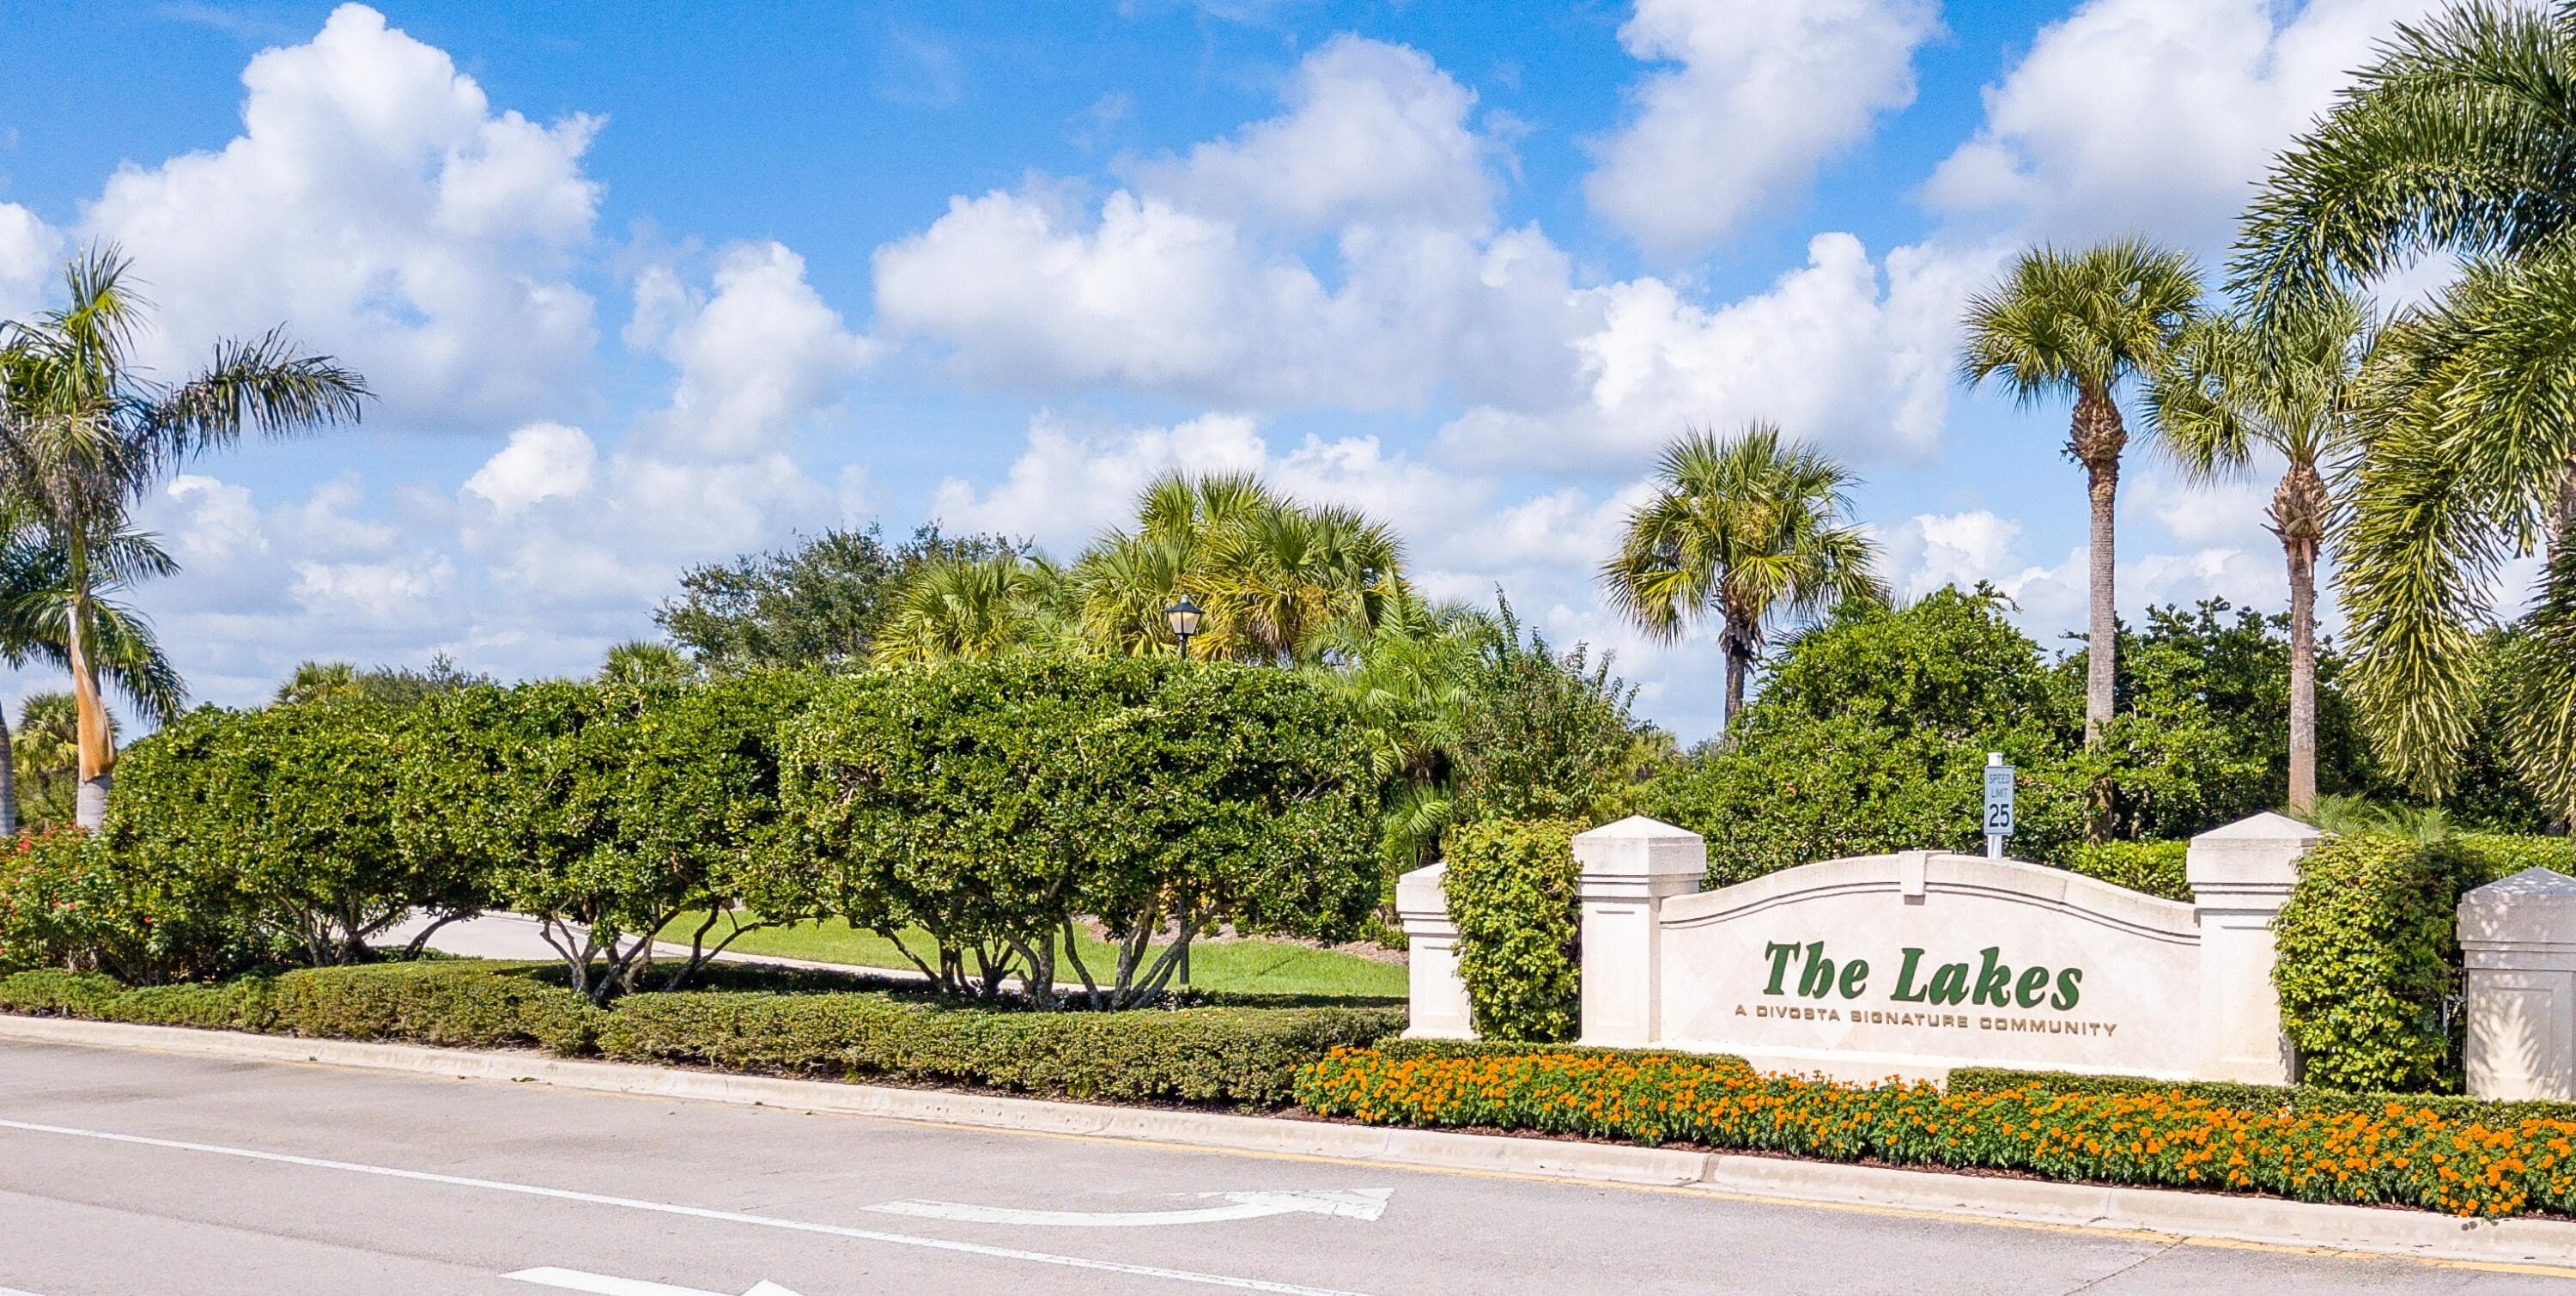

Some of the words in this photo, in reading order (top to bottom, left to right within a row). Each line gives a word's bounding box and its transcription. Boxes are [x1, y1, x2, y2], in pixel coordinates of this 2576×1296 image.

[1989, 774, 2010, 784] SPEED
[1991, 788, 2008, 798] LIMIT
[1989, 803, 2009, 828] 25
[1763, 940, 1869, 1000] The
[1889, 946, 2083, 1011] Lakes
[1735, 1004, 1747, 1017] A
[1756, 1005, 1841, 1022] DIVOSTA
[1850, 1010, 1969, 1028] SIGNATURE
[1979, 1017, 2117, 1037] COMMUNITY
